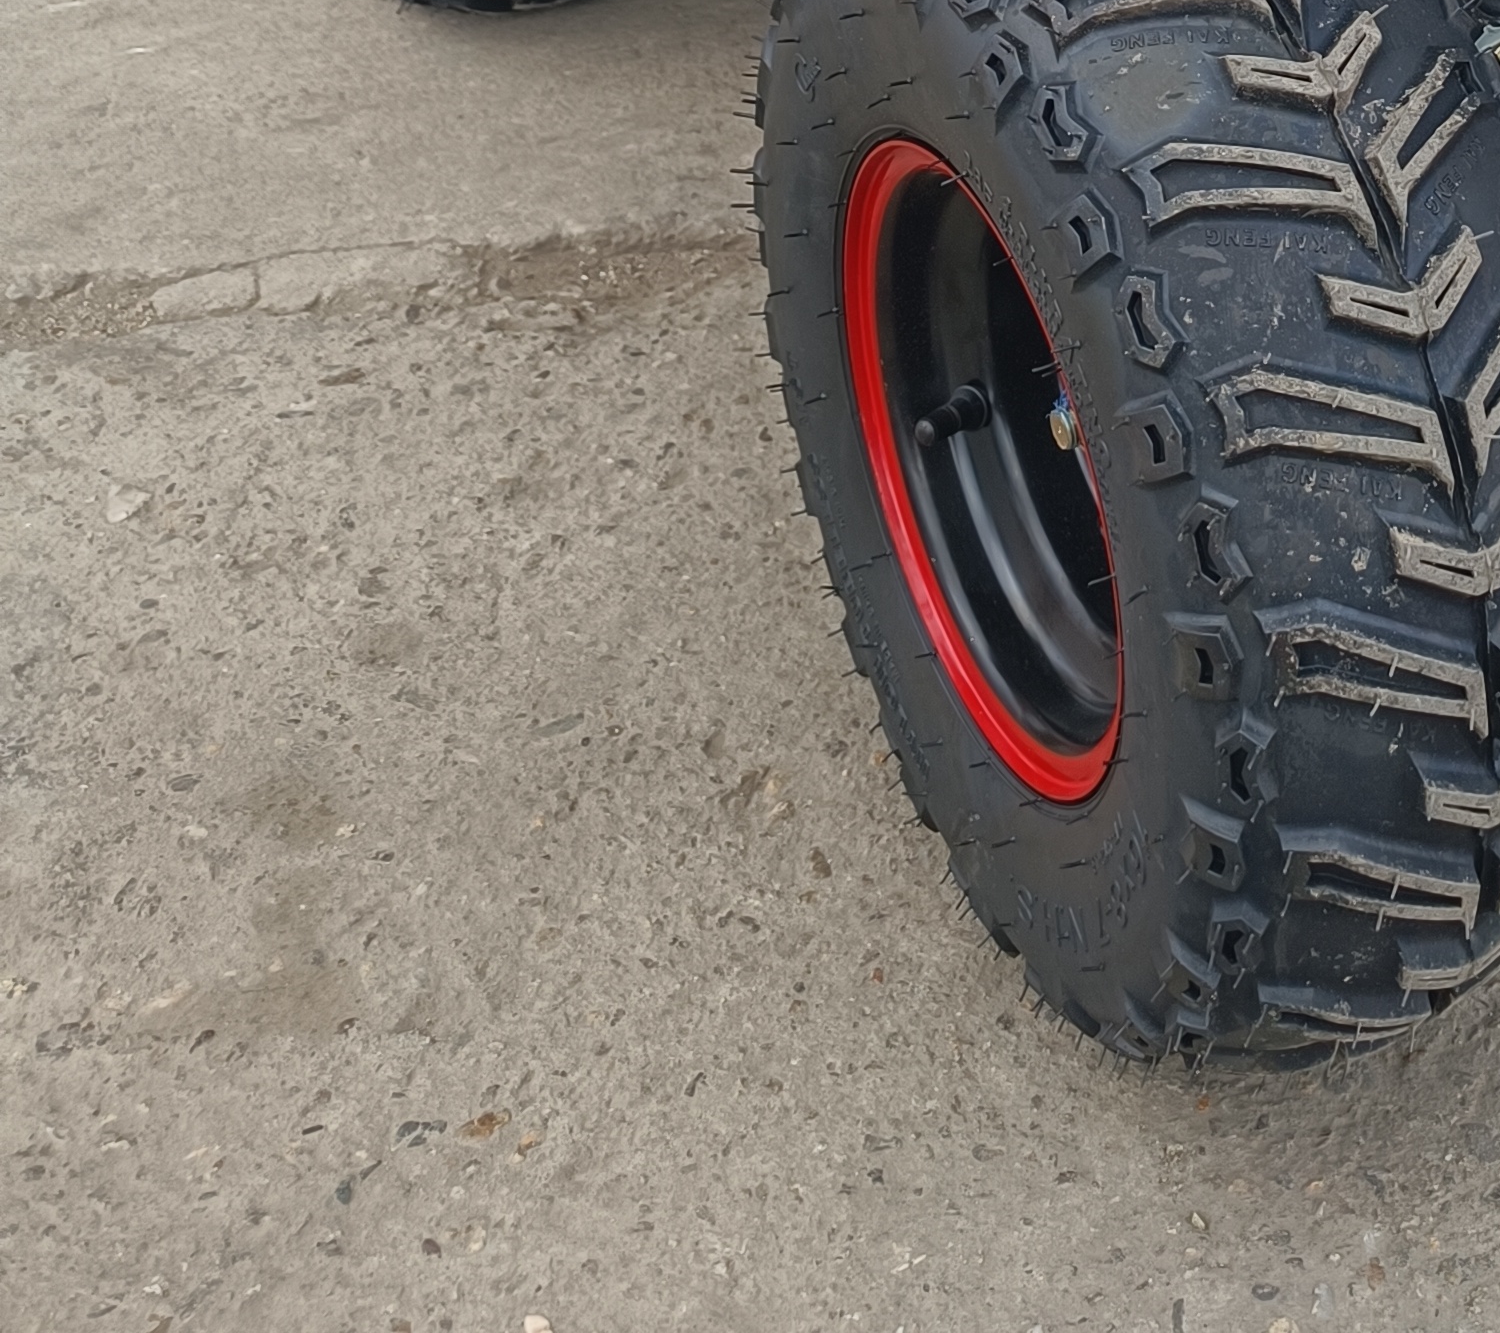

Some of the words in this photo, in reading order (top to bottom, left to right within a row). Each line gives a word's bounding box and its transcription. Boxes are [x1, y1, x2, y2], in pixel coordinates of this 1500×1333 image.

[1110, 32, 1175, 53] FENG
[1186, 25, 1231, 44] KAI
[1423, 166, 1467, 217] FENG
[1204, 227, 1273, 249] FENG
[1283, 230, 1329, 254] KAI
[1358, 474, 1403, 501] KAI
